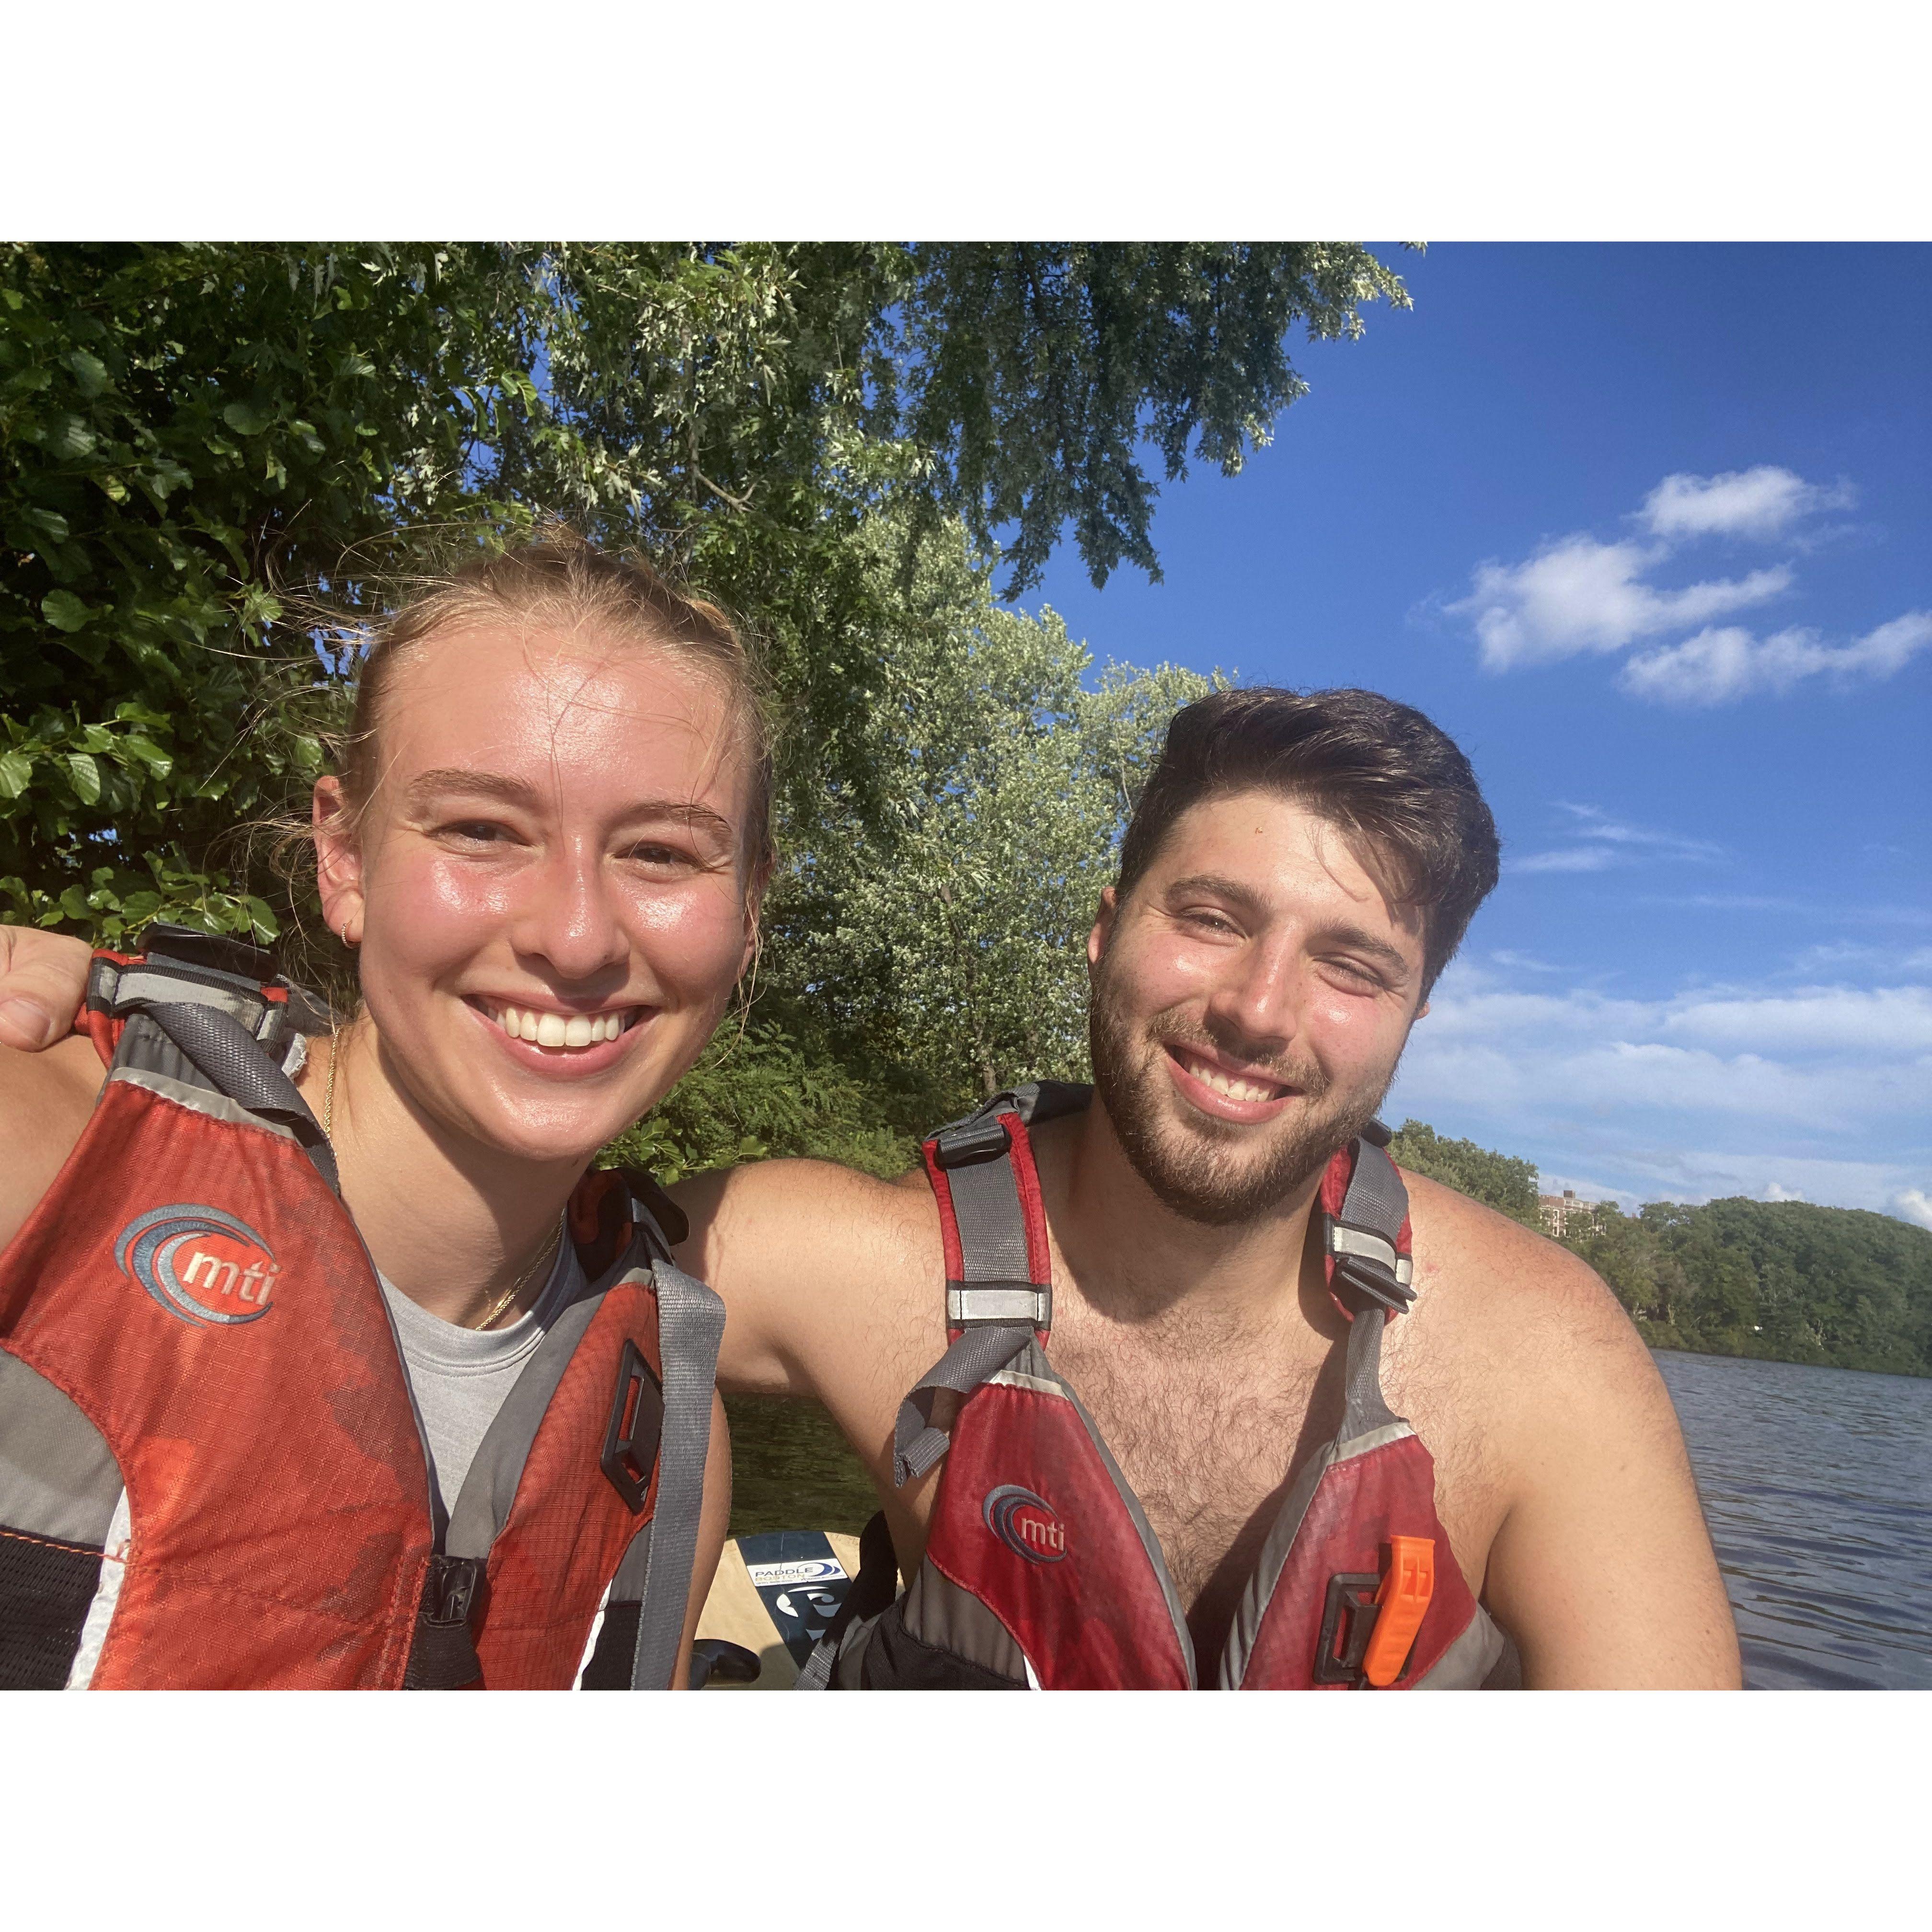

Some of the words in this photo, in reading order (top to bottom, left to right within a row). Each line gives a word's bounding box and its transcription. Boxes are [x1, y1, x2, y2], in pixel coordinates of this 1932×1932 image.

[183, 1252, 281, 1305] mti
[1021, 1518, 1065, 1551] mti
[756, 1567, 813, 1577] PADDLE
